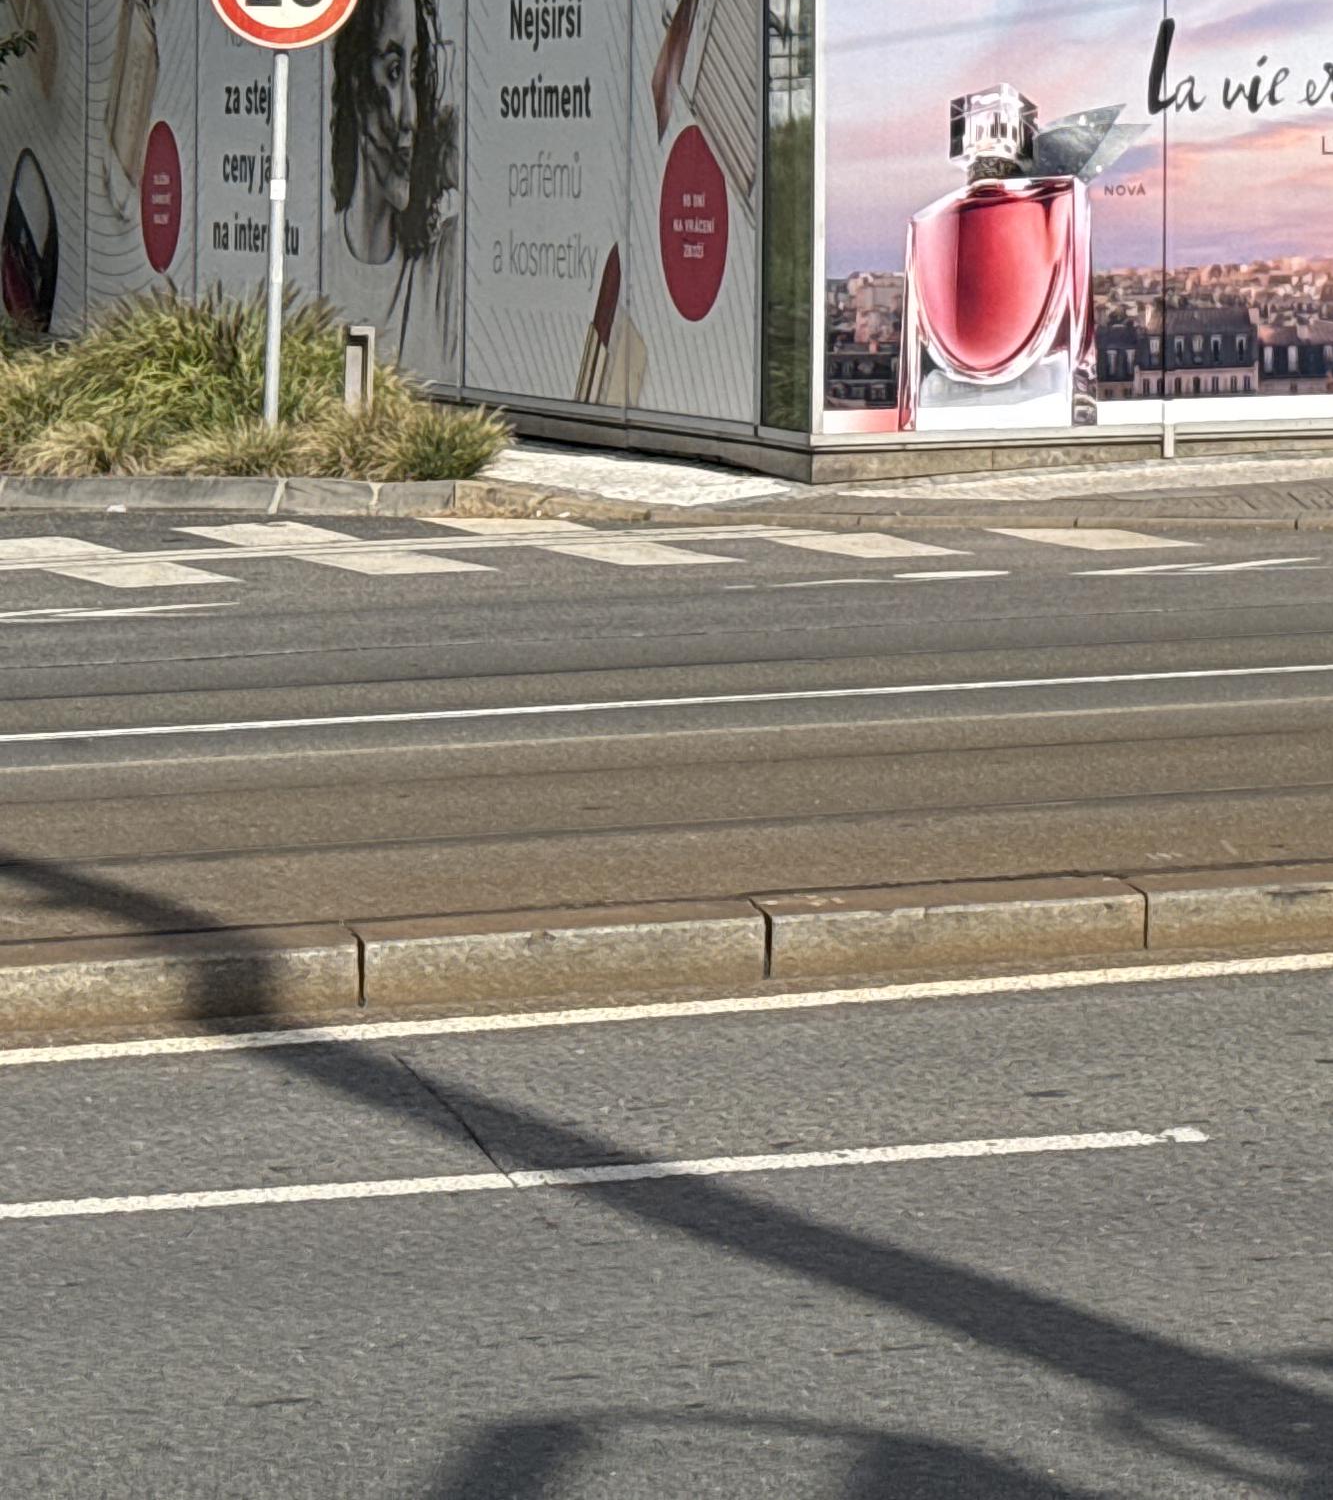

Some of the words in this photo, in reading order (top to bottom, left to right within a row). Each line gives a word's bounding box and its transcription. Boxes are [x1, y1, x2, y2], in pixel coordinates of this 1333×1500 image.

[1147, 17, 1205, 116] La
[1223, 55, 1291, 113] vie
[225, 85, 240, 115] za
[245, 75, 273, 126] stej
[500, 73, 592, 119] sortiment
[222, 153, 256, 195] ceny
[508, 151, 583, 208] parfémů
[213, 222, 229, 251] na
[234, 211, 299, 256] intertu
[509, 231, 598, 292] kosmetiky
